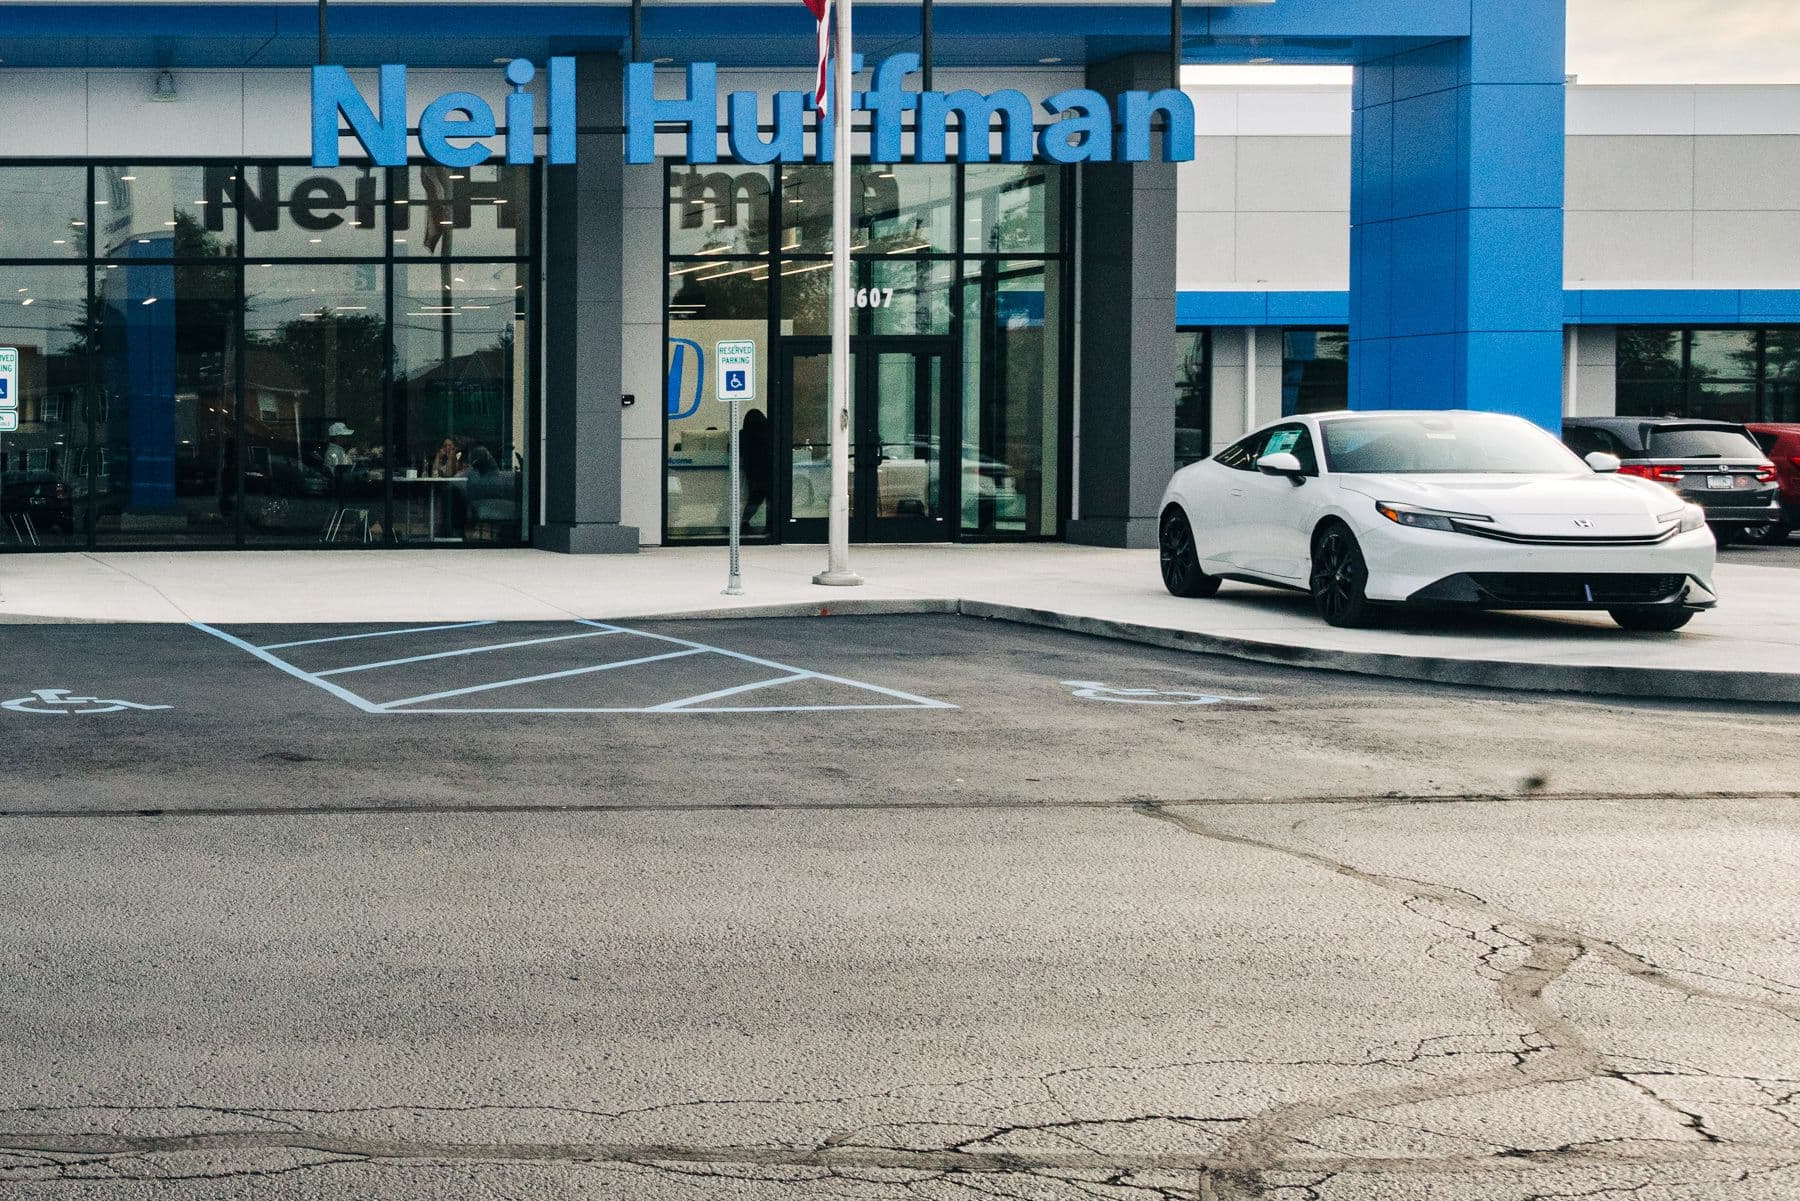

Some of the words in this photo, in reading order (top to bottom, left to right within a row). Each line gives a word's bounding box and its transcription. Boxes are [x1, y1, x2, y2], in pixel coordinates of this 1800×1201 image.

[310, 56, 577, 168] Neil
[719, 346, 752, 355] RESERVED
[721, 356, 750, 364] PARKING
